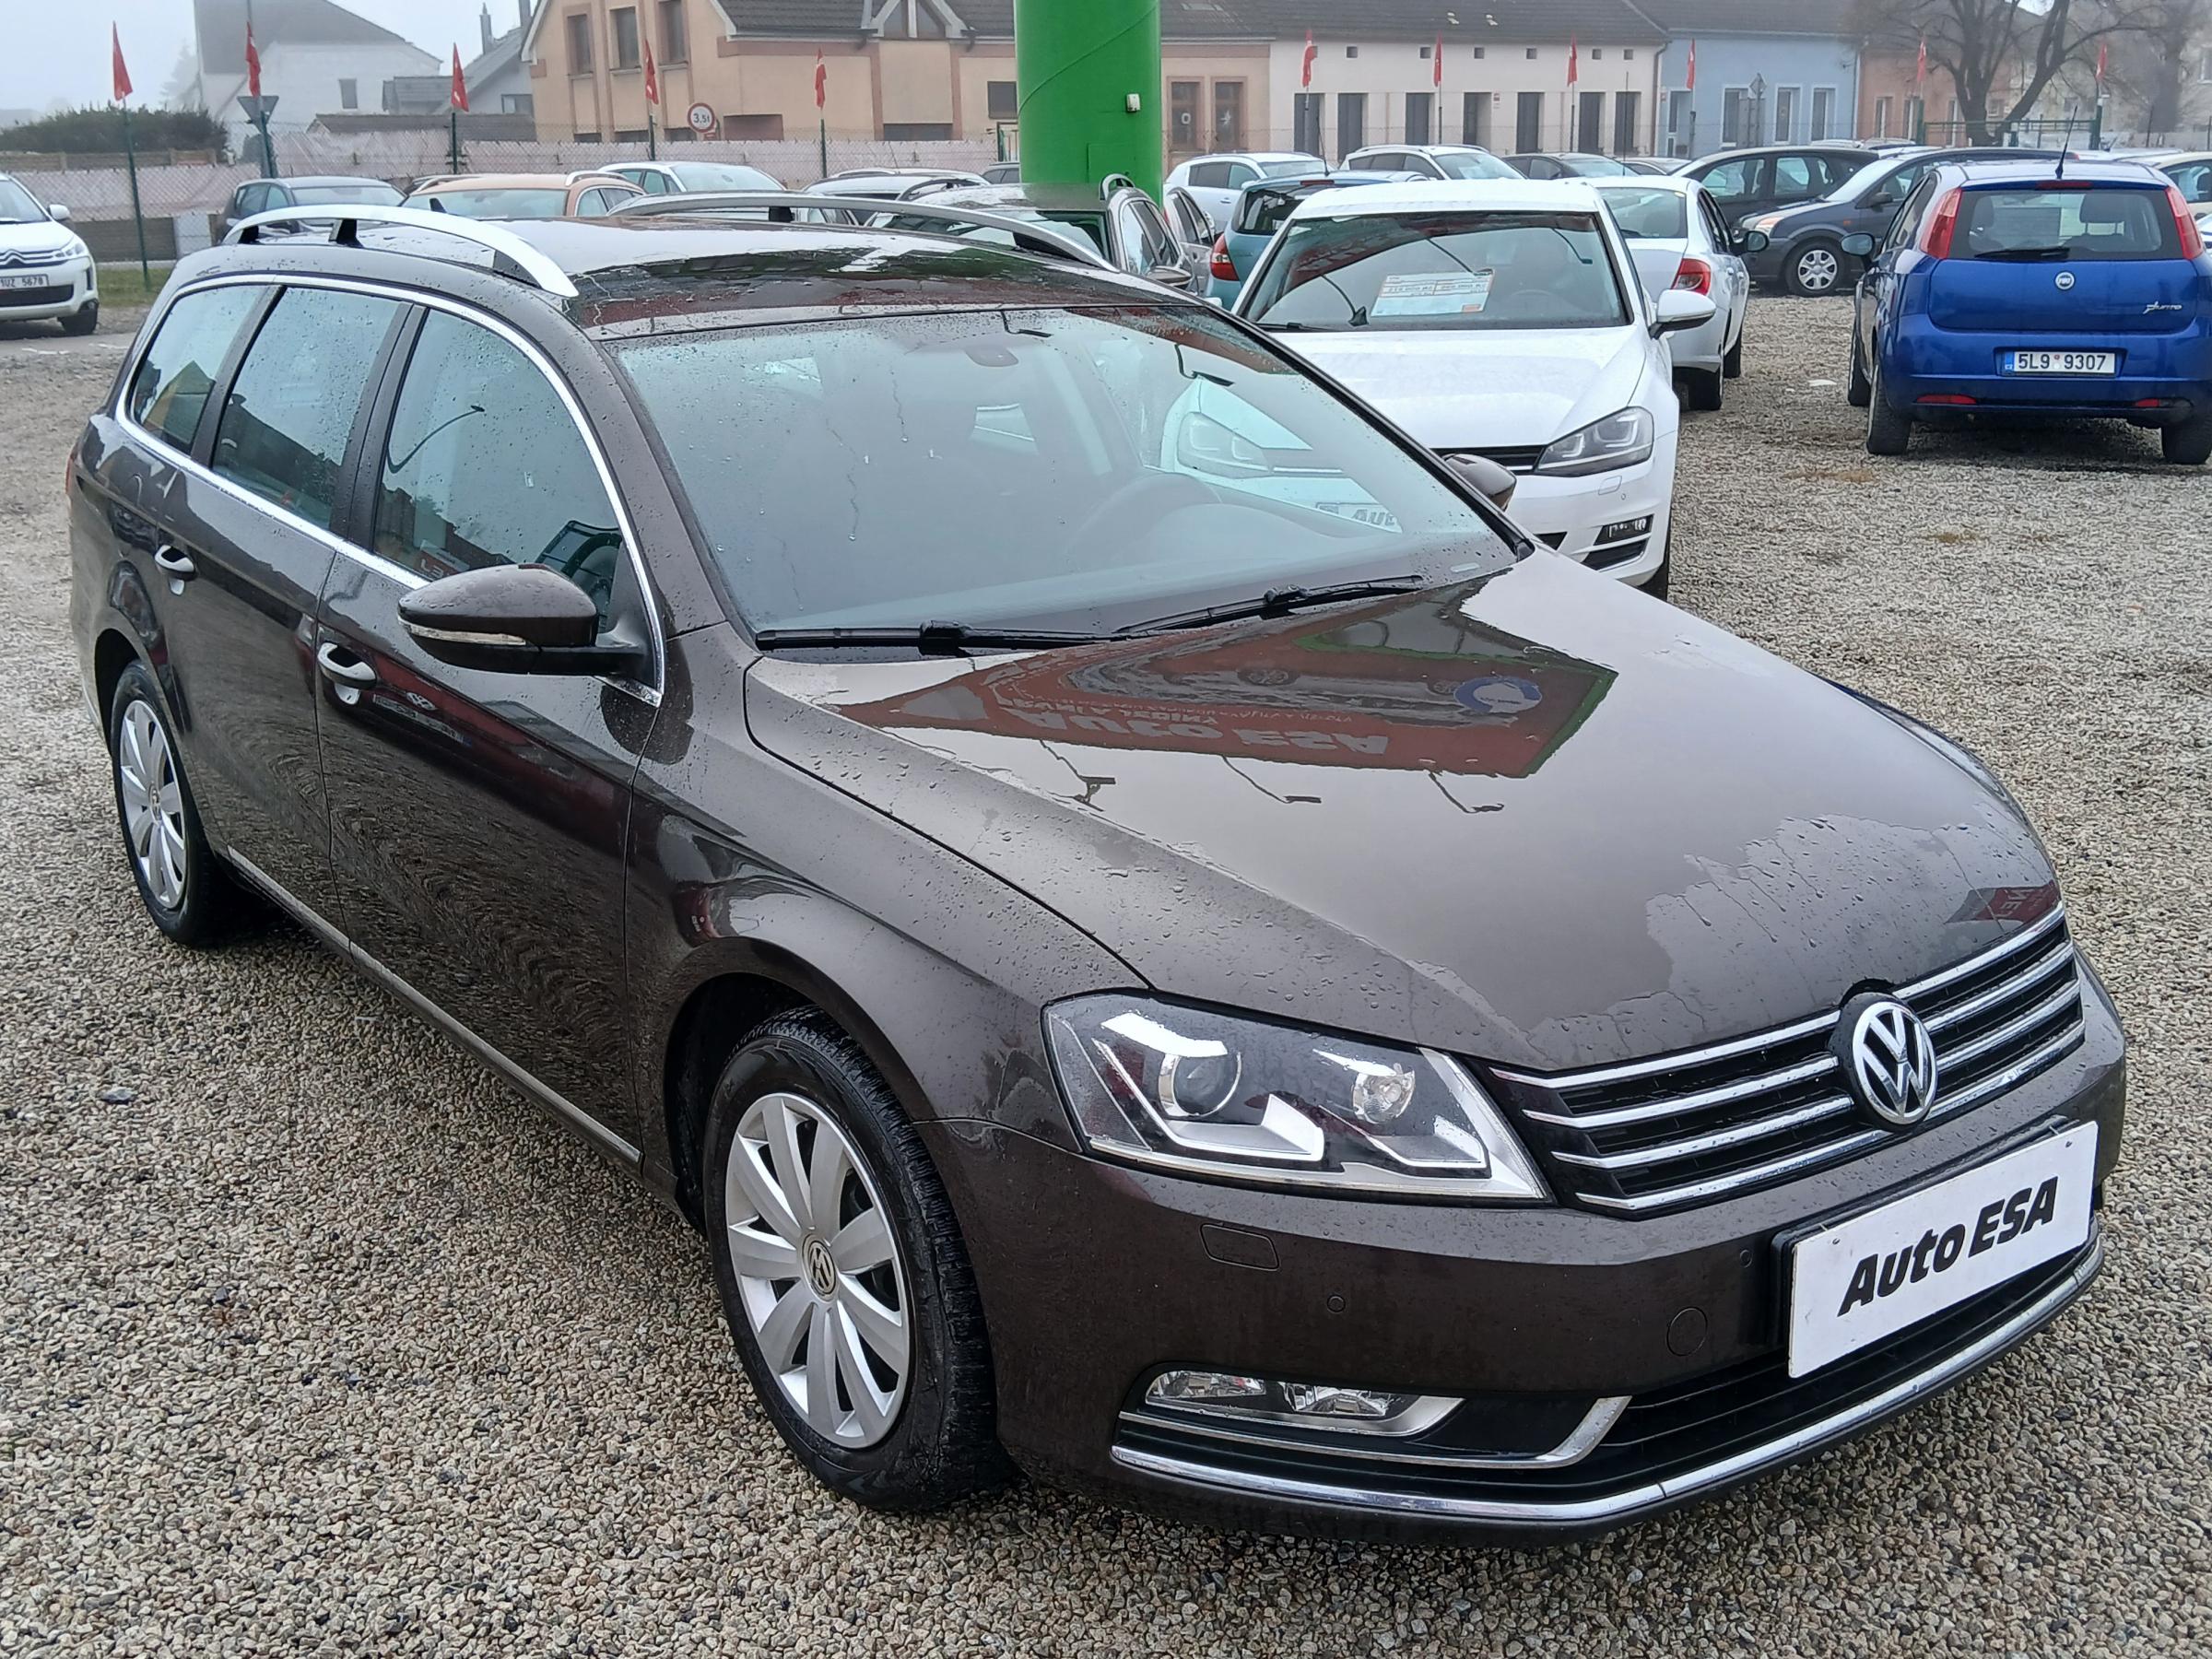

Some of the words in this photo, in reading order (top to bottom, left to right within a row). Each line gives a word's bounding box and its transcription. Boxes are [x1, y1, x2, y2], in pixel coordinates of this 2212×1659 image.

[2018, 353, 2051, 370] 5L9
[2064, 354, 2107, 371] 9307
[1837, 1224, 1966, 1317] Auto
[1968, 1176, 2059, 1258] ESA
